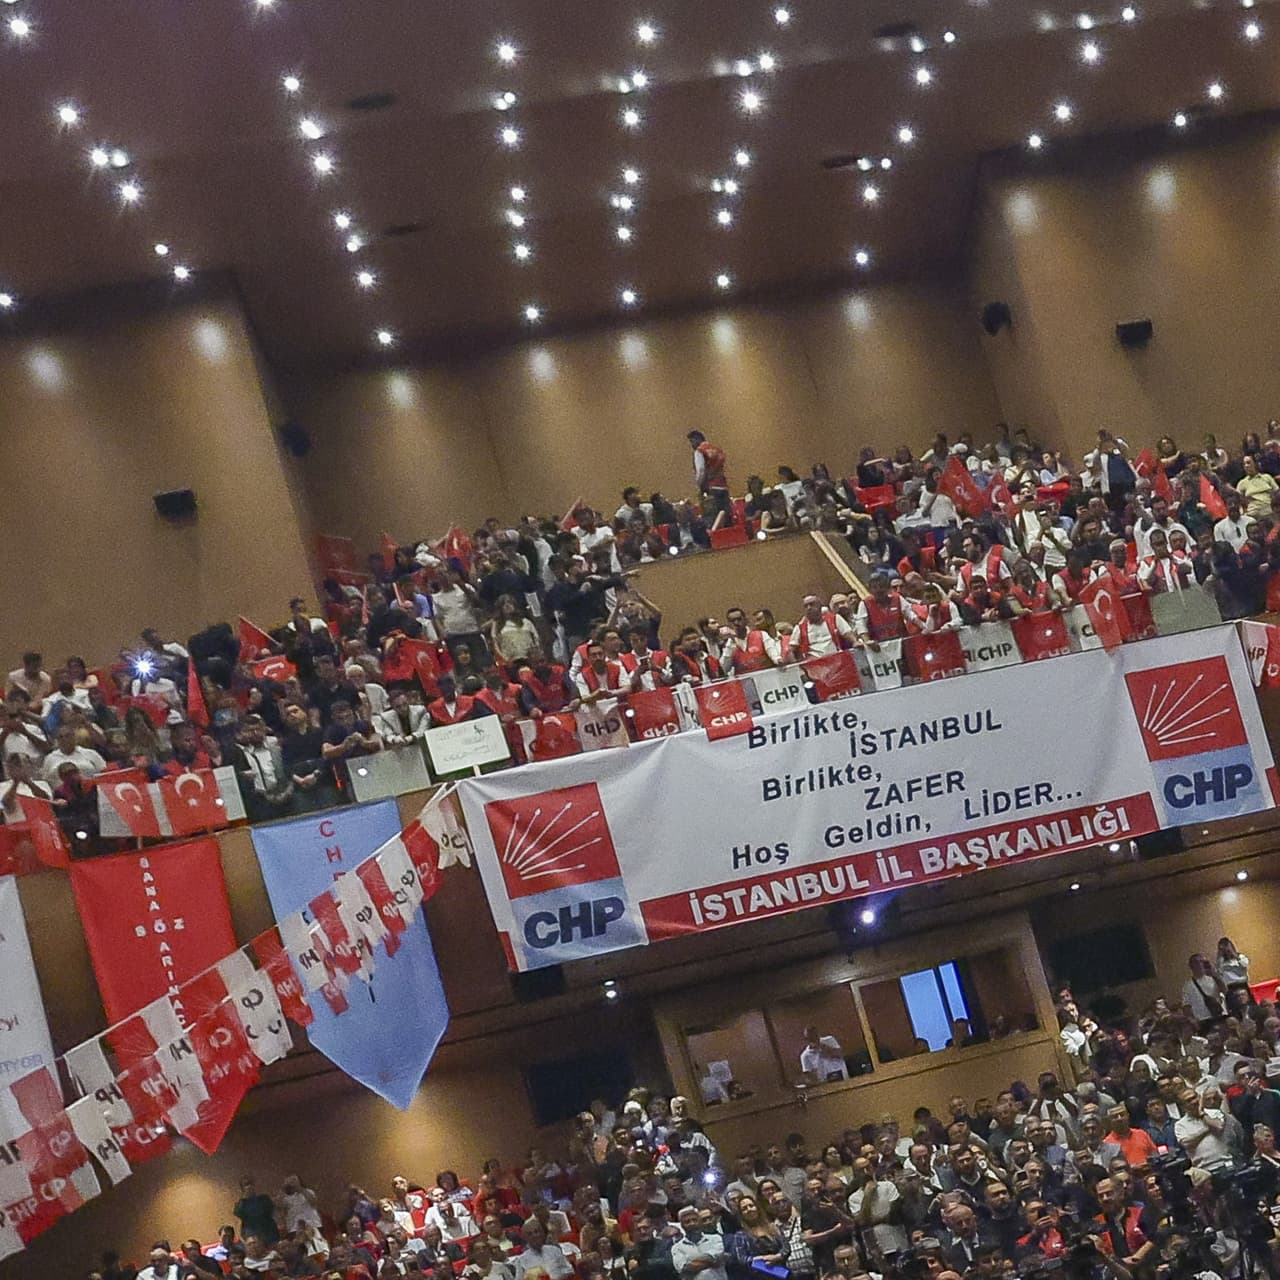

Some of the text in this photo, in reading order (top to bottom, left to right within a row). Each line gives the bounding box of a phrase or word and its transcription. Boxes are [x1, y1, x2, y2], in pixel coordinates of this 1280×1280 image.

[978, 643, 1014, 661] CHP
[764, 685, 801, 706] CHP
[711, 712, 748, 728] CHP
[750, 710, 869, 750] Birlikte,
[850, 708, 1003, 758] İSTANBUL
[762, 762, 883, 802] Birlikte,
[864, 770, 967, 811] ZAFER
[1164, 763, 1253, 809] CHP
[732, 840, 790, 870] Hoş
[824, 813, 932, 849] Geldin,
[688, 804, 1132, 926] İSTANBUL İL BAŞKANLIĞI
[524, 896, 626, 949] CHP
